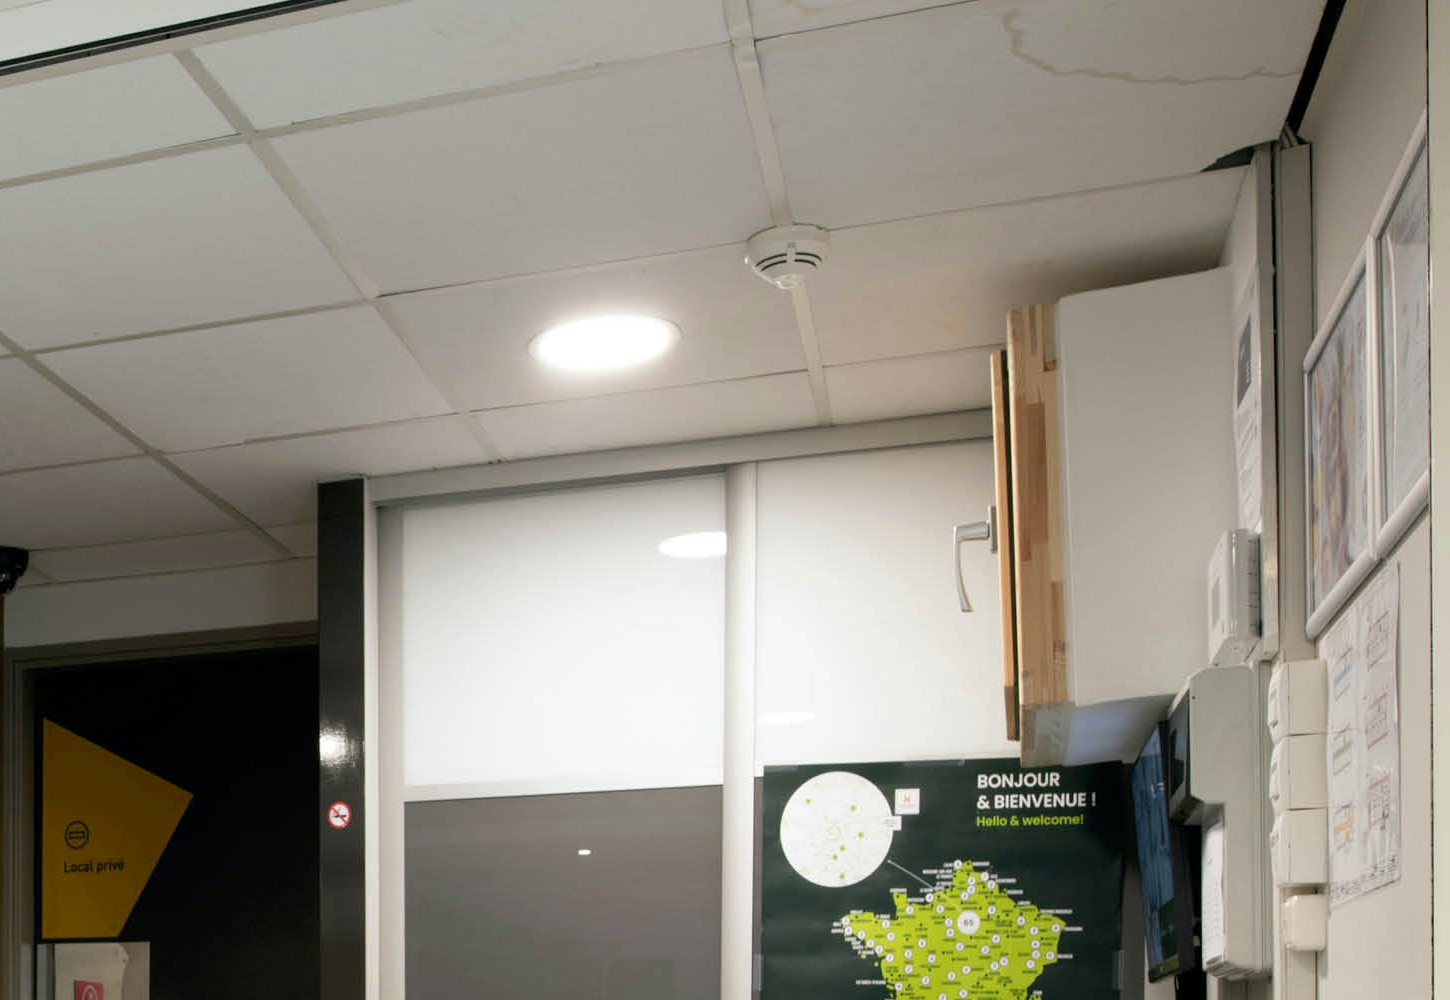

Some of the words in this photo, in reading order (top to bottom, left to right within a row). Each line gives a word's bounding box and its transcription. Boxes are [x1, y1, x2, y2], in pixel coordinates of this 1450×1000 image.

[977, 772, 1061, 789] BONJOUR
[977, 794, 991, 810] &
[994, 792, 1087, 809] BIENVENUE
[976, 815, 1008, 828] Hello
[1010, 815, 1020, 827] &
[1022, 813, 1085, 827] welcome!
[64, 860, 93, 873] Local
